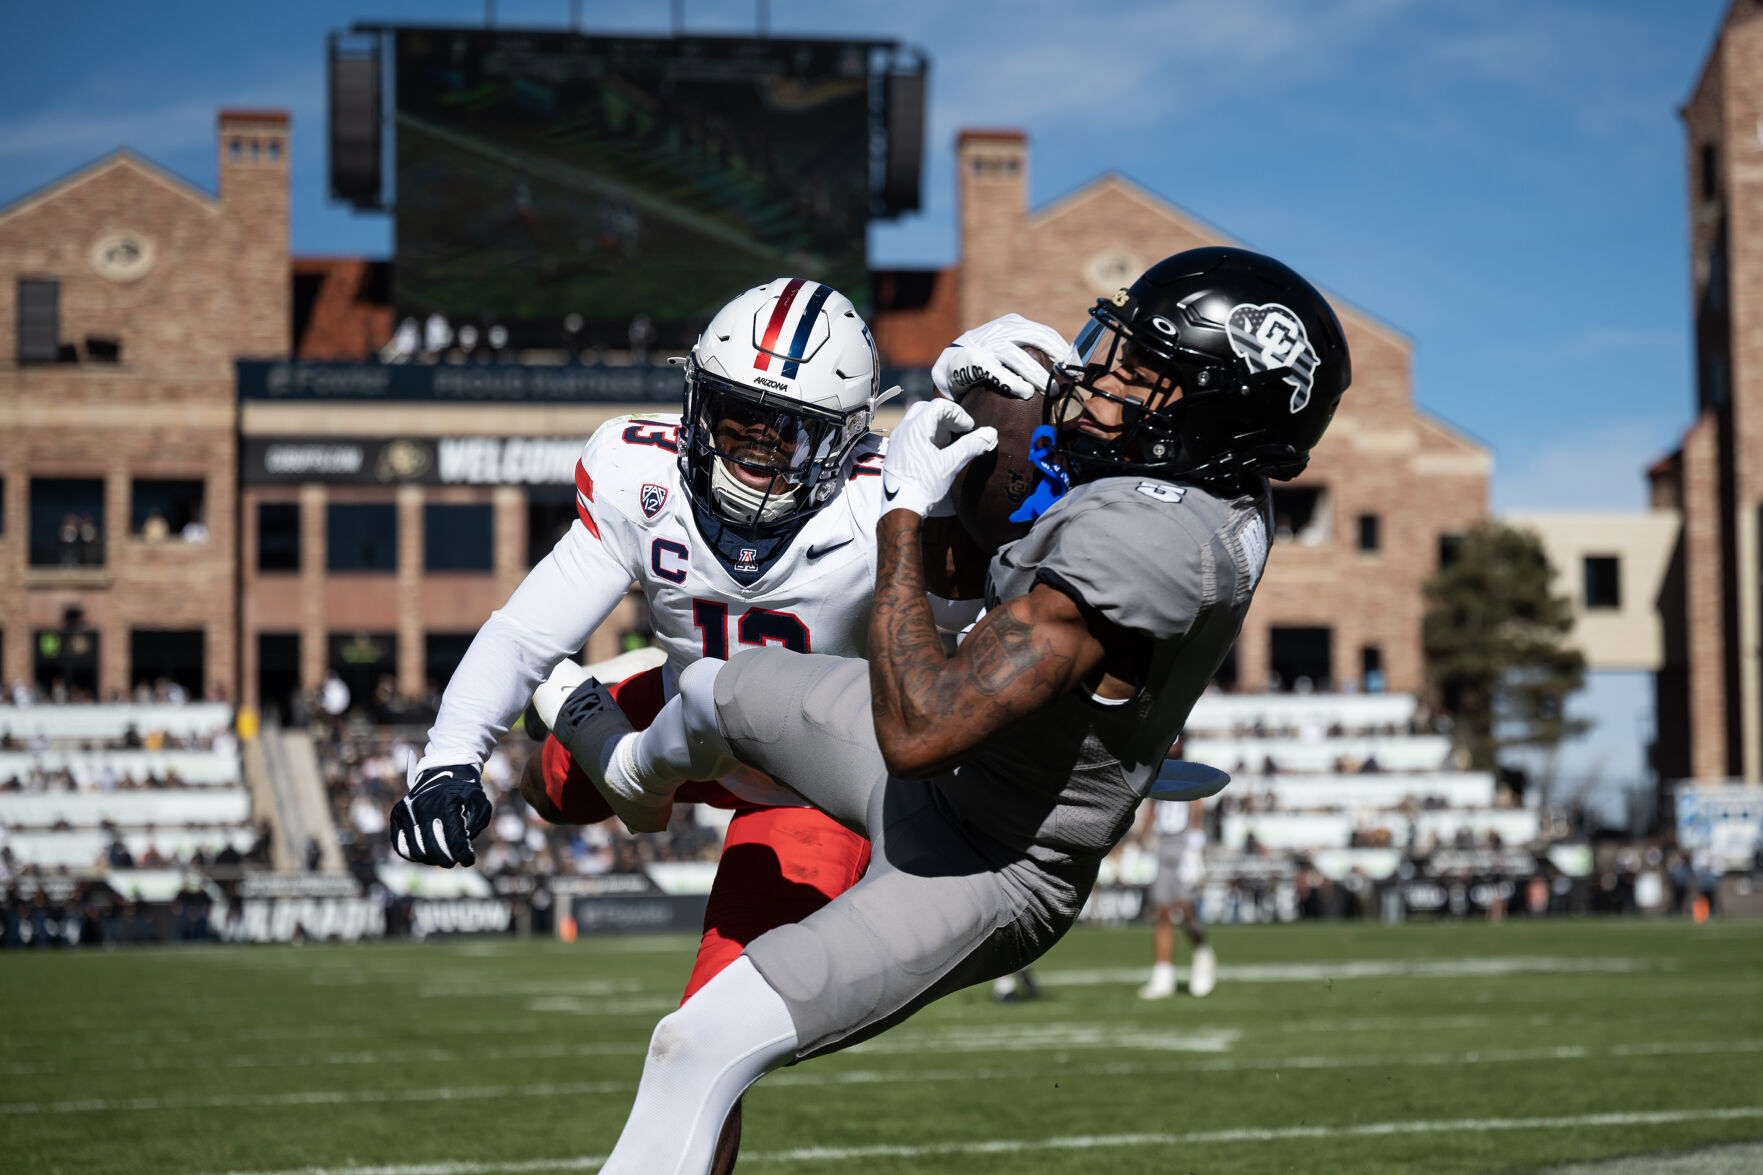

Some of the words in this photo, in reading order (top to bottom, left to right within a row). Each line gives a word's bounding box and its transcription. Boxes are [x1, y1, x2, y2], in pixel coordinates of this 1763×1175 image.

[1255, 311, 1306, 371] CU
[753, 376, 788, 392] ARIZONA
[438, 438, 582, 484] WELCOM
[642, 485, 667, 504] PAC
[644, 498, 660, 512] 12
[652, 538, 689, 584] C
[734, 548, 759, 572] A
